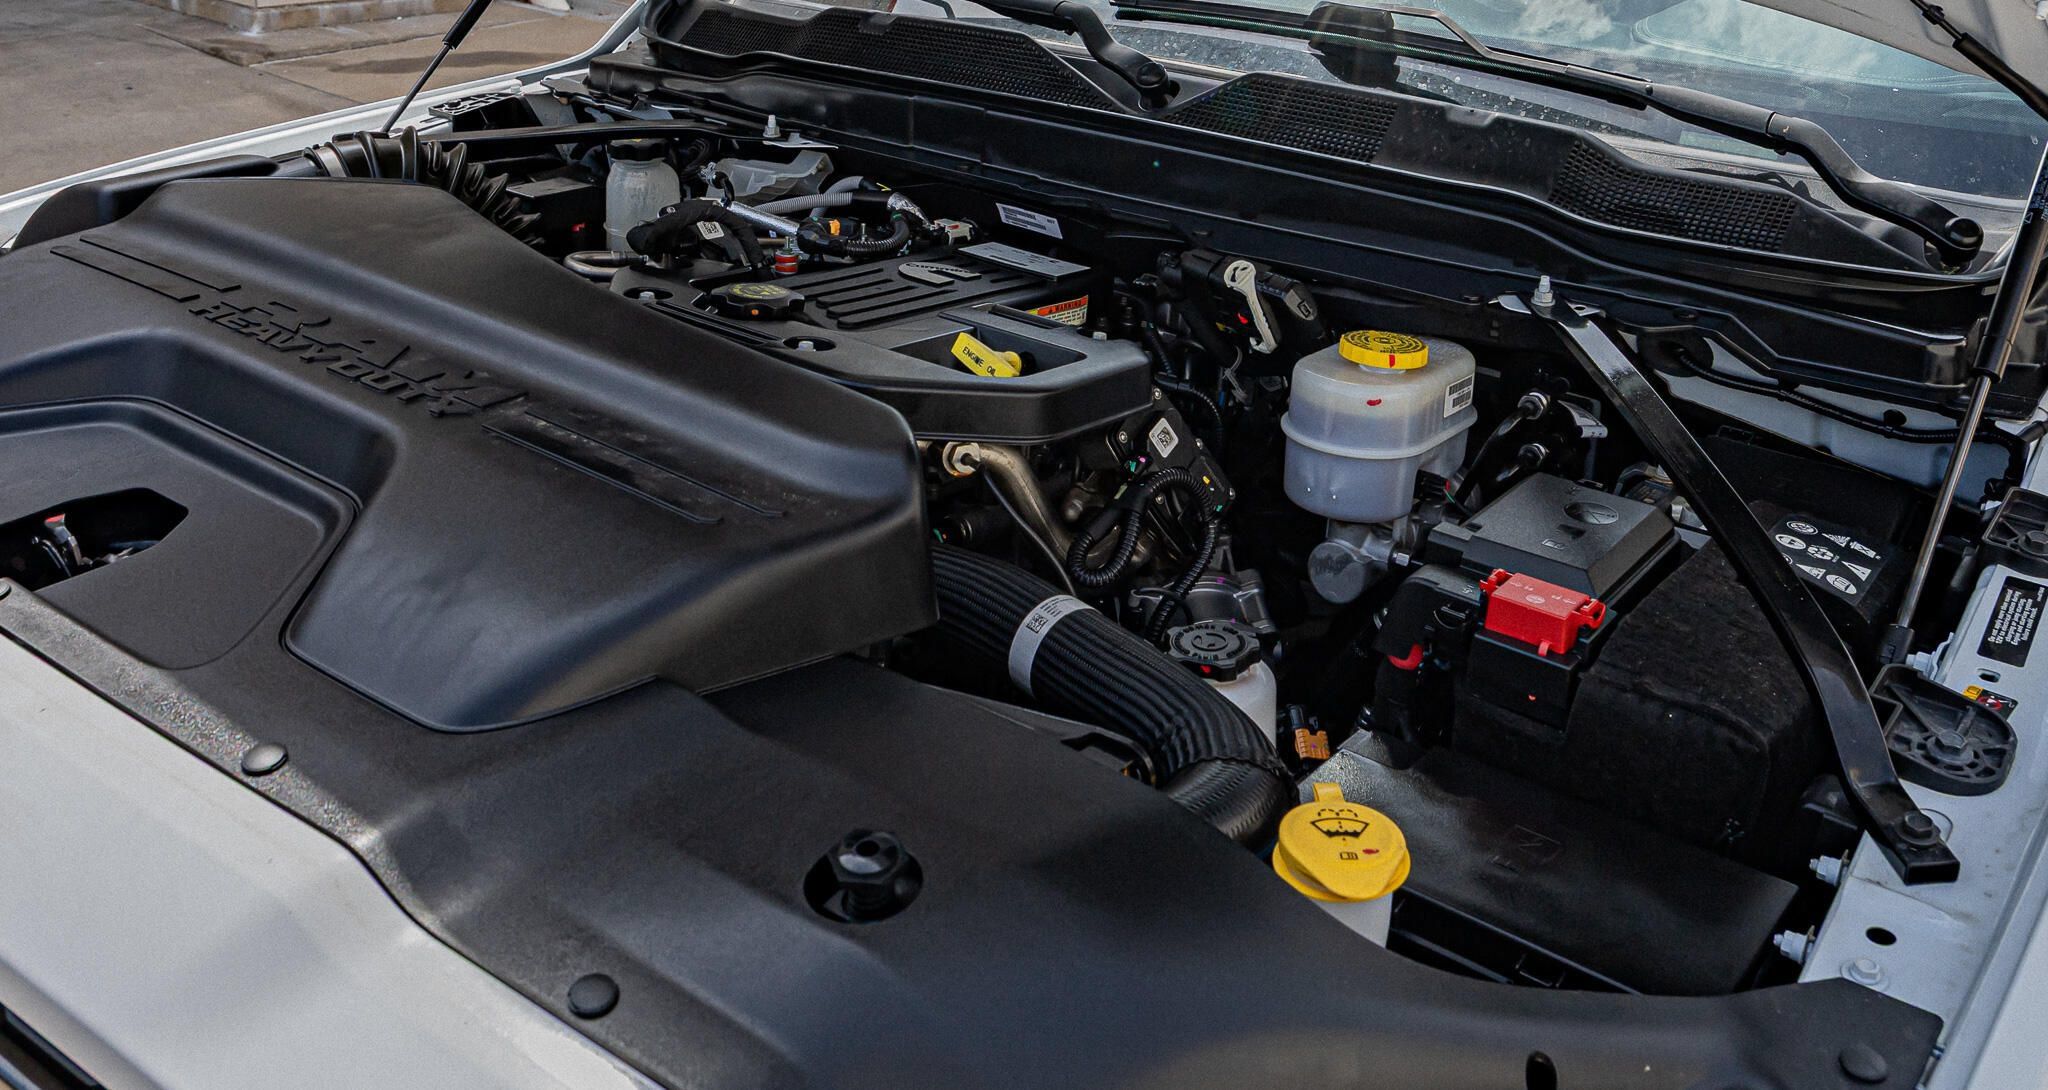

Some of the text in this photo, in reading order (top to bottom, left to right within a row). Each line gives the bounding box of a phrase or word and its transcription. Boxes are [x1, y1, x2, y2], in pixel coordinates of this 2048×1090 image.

[188, 304, 342, 363] HEAVY
[220, 292, 530, 409] RAM
[962, 346, 984, 367] ENGINE
